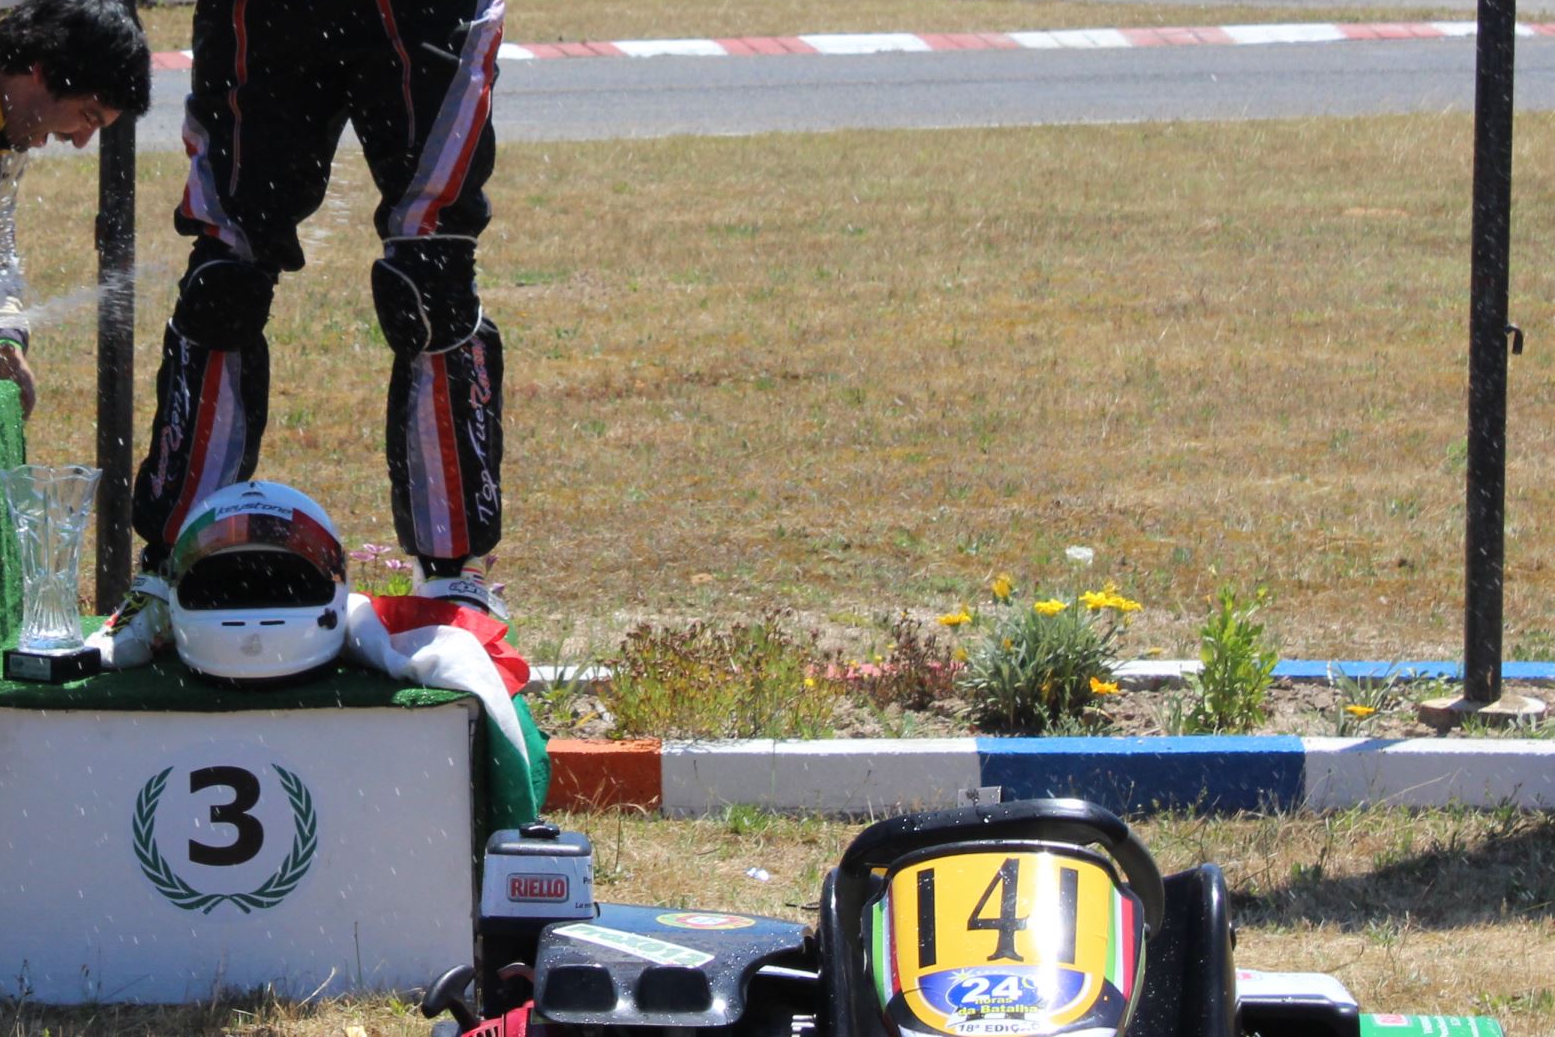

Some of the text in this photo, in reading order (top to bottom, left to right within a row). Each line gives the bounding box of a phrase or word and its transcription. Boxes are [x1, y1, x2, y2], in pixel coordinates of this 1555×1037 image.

[188, 765, 264, 866] 3
[510, 877, 566, 898] RIELLO
[960, 976, 1023, 1003] 24
[958, 1004, 1038, 1016] da Batalha
[985, 1023, 1041, 1034] EDIÇO
